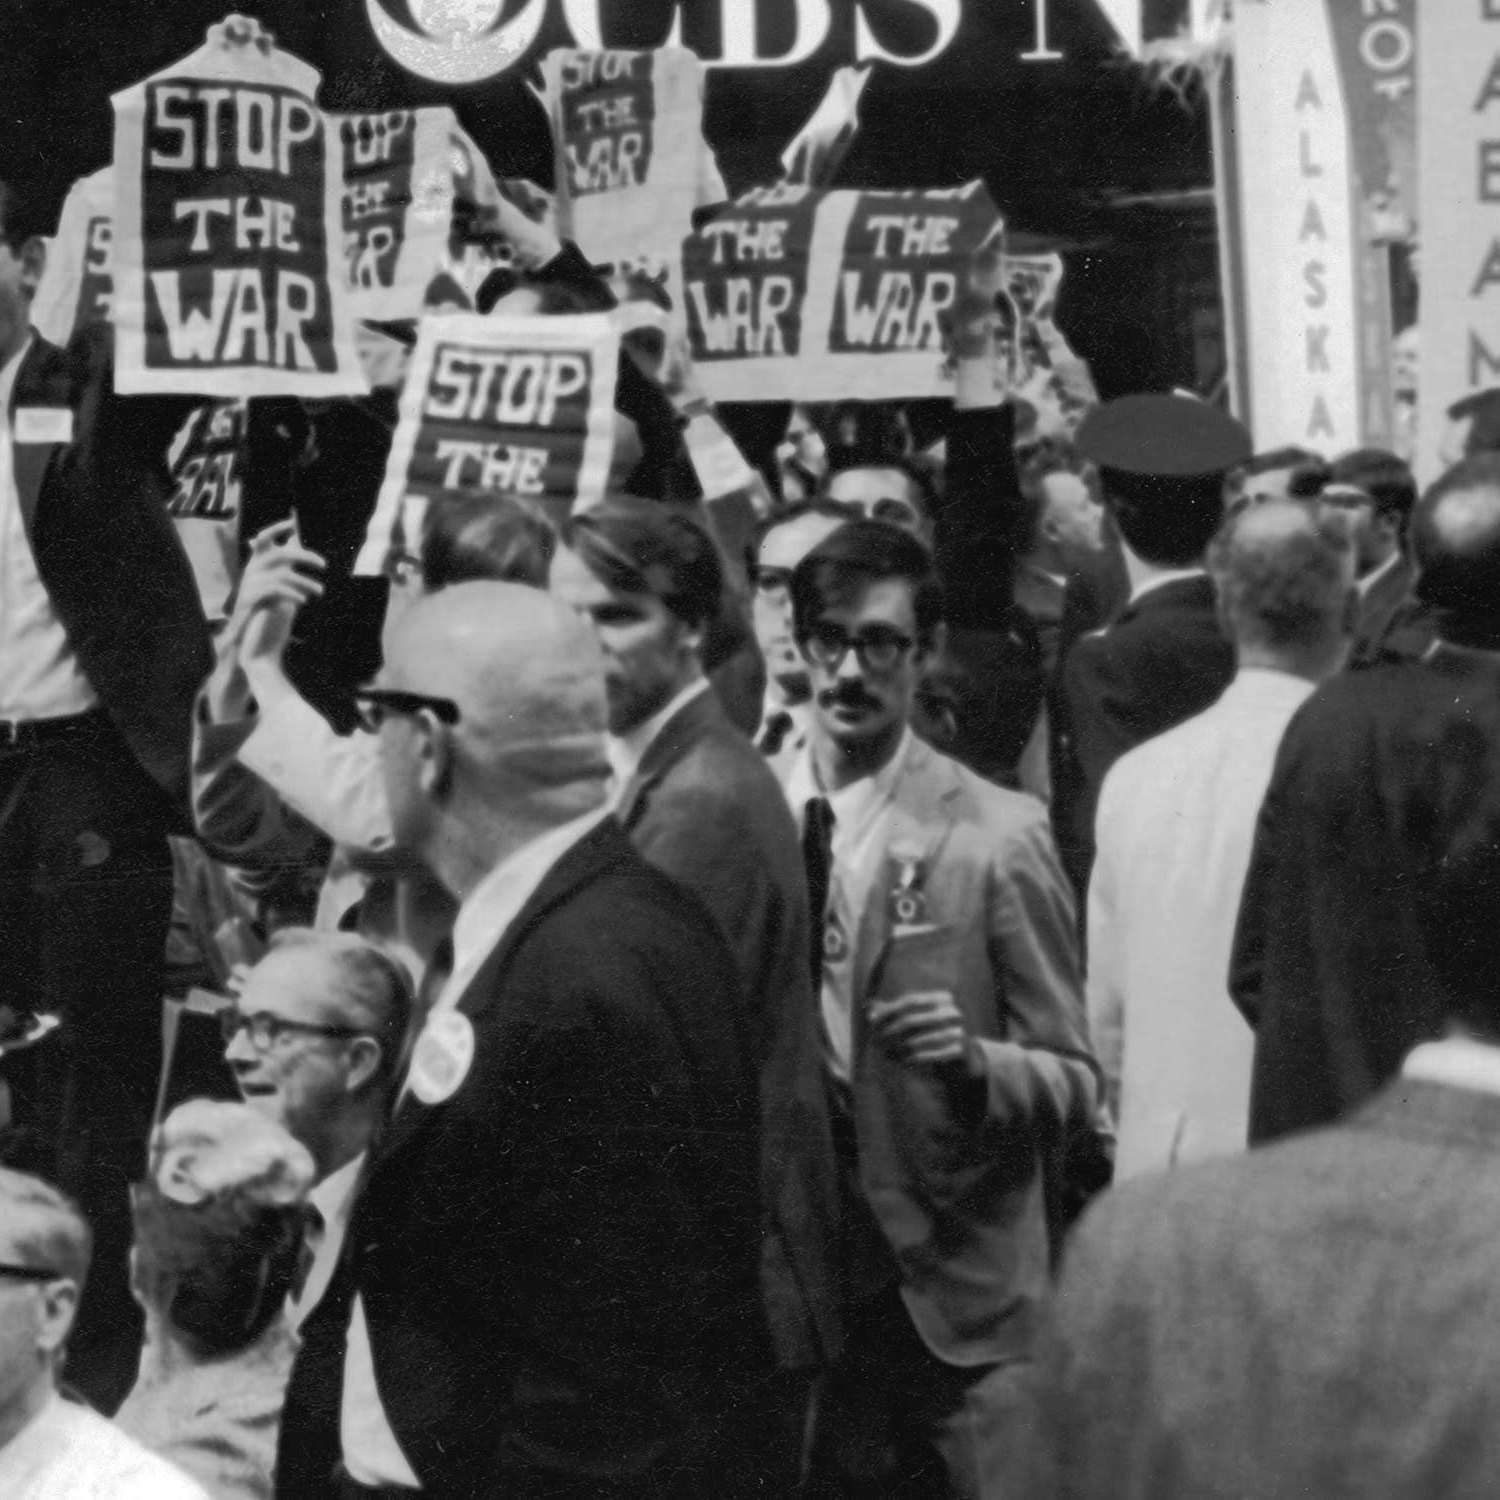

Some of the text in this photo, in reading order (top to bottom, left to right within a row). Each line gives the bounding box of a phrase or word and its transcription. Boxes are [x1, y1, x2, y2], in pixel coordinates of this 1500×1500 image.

[151, 86, 317, 175] STOP
[577, 97, 638, 131] THE
[564, 133, 643, 189] WAR
[174, 198, 300, 252] THE
[702, 220, 789, 264] THE
[867, 215, 959, 259] THE
[1293, 66, 1338, 440] ALASKA
[150, 267, 318, 372] WAR
[689, 276, 793, 353] WAR
[843, 271, 956, 347] WAR
[427, 350, 588, 427] STOP
[436, 438, 549, 494] THE
